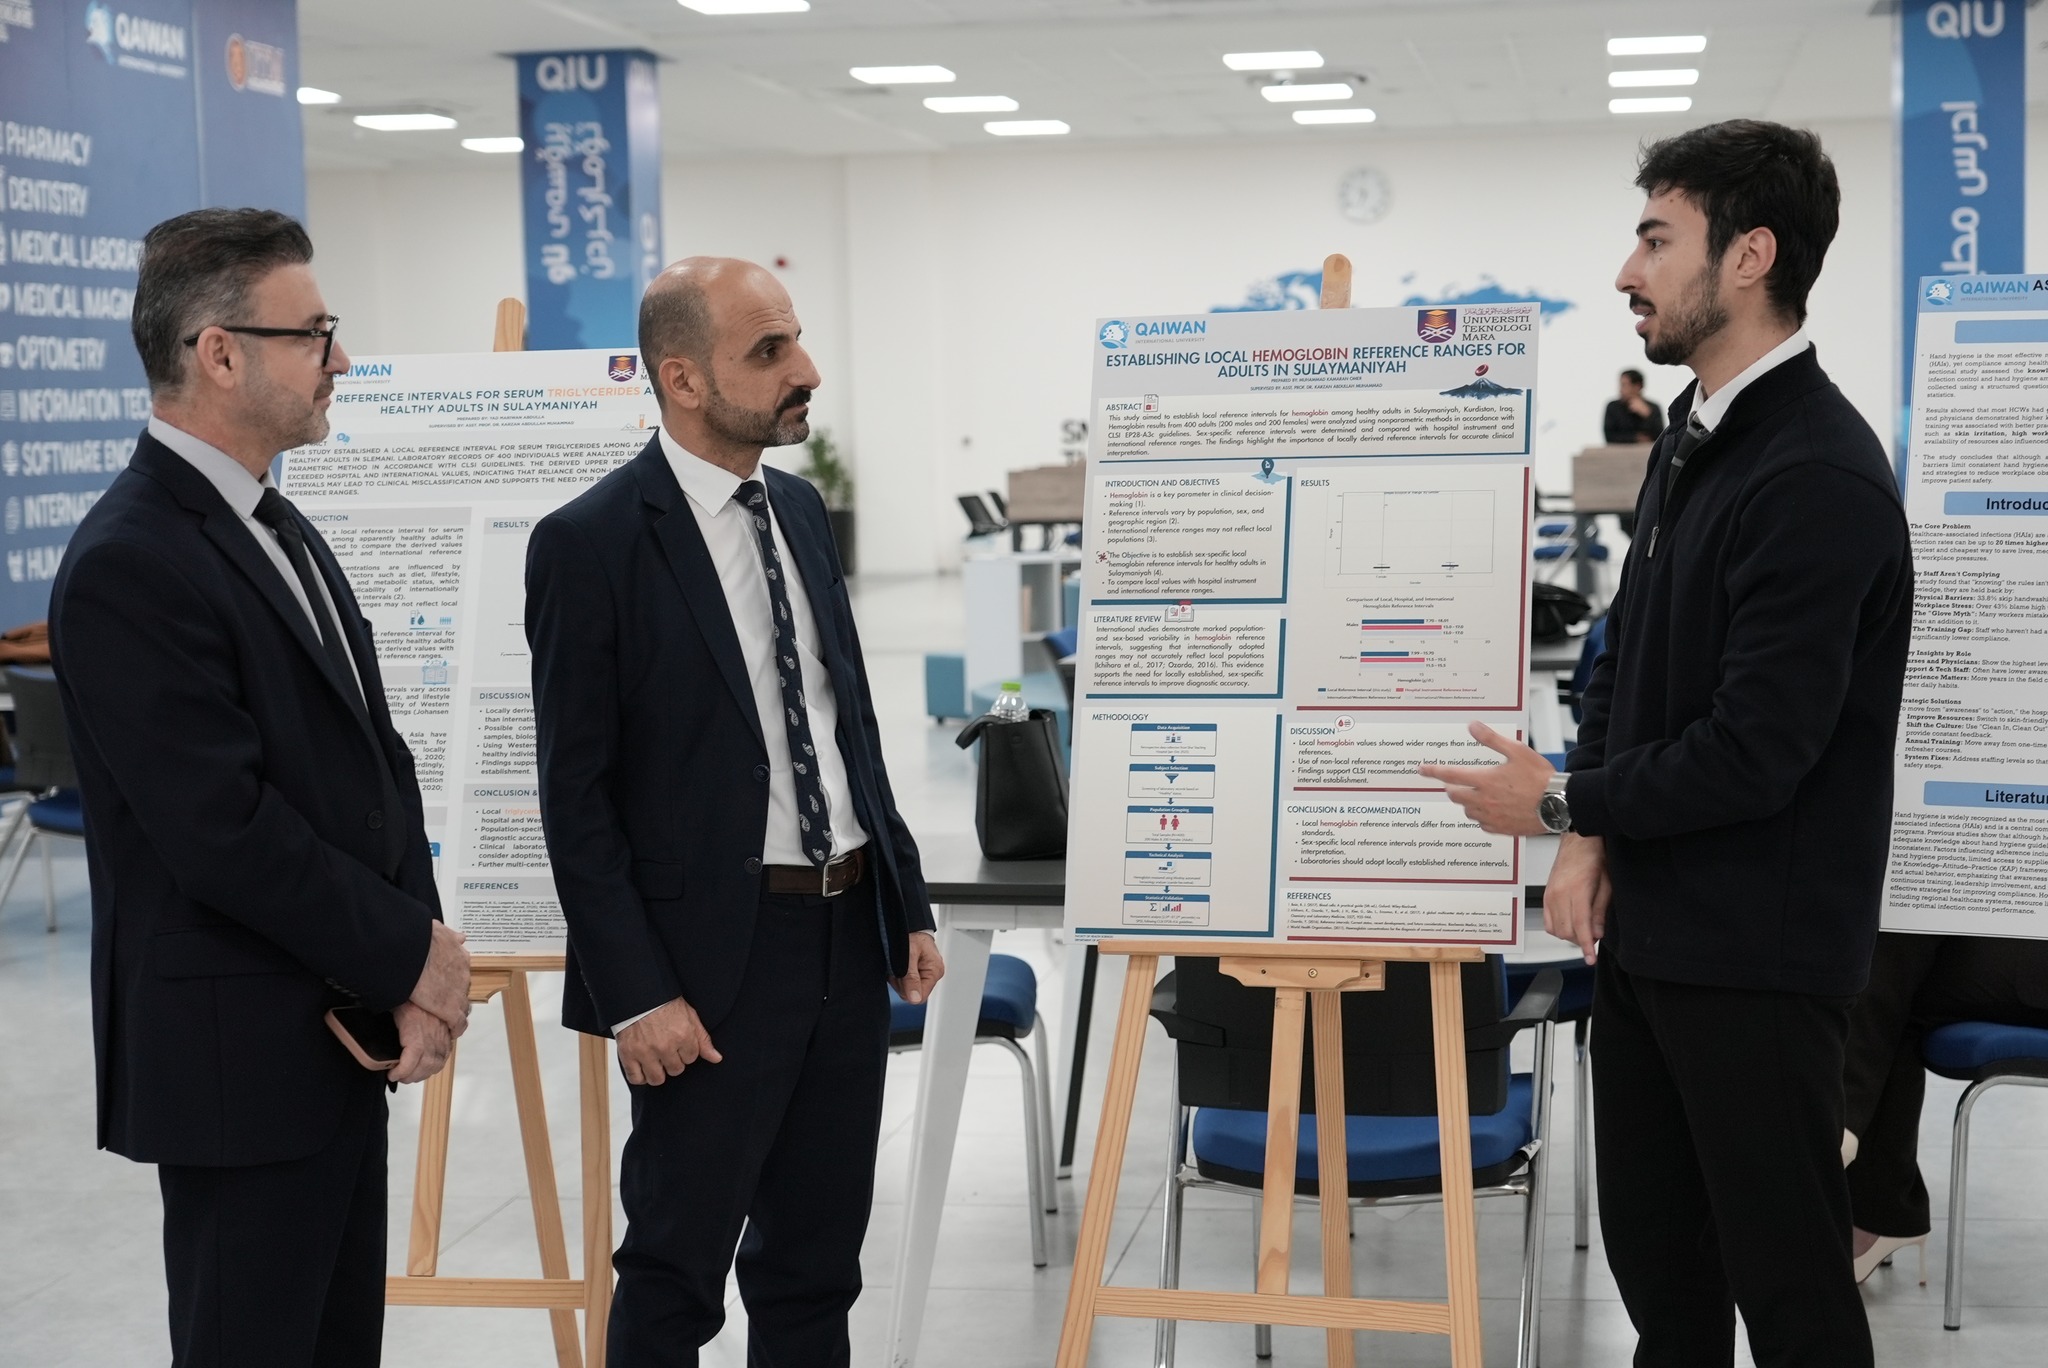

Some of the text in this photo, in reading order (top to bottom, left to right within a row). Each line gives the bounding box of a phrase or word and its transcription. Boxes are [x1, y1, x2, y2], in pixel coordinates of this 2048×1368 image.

[1926, 1, 2005, 39] QIU
[115, 12, 185, 60] QAIWAN
[536, 55, 607, 91] QIU
[6, 121, 91, 166] PHARMACY
[1941, 101, 1988, 196] ادرس
[8, 176, 87, 216] DENTISTRY
[11, 229, 79, 267] MEDICAL
[1961, 281, 2028, 294] QAIWAN
[14, 282, 82, 318] MEDICAL
[1136, 321, 1206, 336] QAIWAN
[1463, 316, 1529, 324] UNIVERSITI
[1463, 324, 1531, 332] TEKNOLOGI
[16, 335, 106, 371] OPTOMETRY
[1107, 343, 1525, 367] ESTABLISHING LOCAL HEMOGLOBIN REFERENCE RANGES FOR
[1218, 361, 1406, 377] ADULTS IN SULAYMANIYAH
[18, 387, 119, 422] INFORMATION
[336, 393, 404, 402] REFERENCE
[408, 391, 472, 400] INTERVALS
[476, 391, 500, 399] FOR
[504, 390, 543, 398] SERUM
[548, 387, 640, 397] TRIGLYCERIDES
[381, 405, 434, 414] HEALTHY
[438, 404, 483, 412] ADULTS
[503, 401, 597, 411] SULAYMANIYAH
[1106, 403, 1142, 411] ABSTRACT
[1292, 410, 1328, 418] hemoglobin
[1414, 406, 1460, 415] Sulaymaniyah,
[22, 441, 102, 476] SOFTWARE
[1110, 492, 1148, 500] Hemoglobin
[1366, 858, 1384, 867] adopt
[1386, 859, 1407, 867] locally
